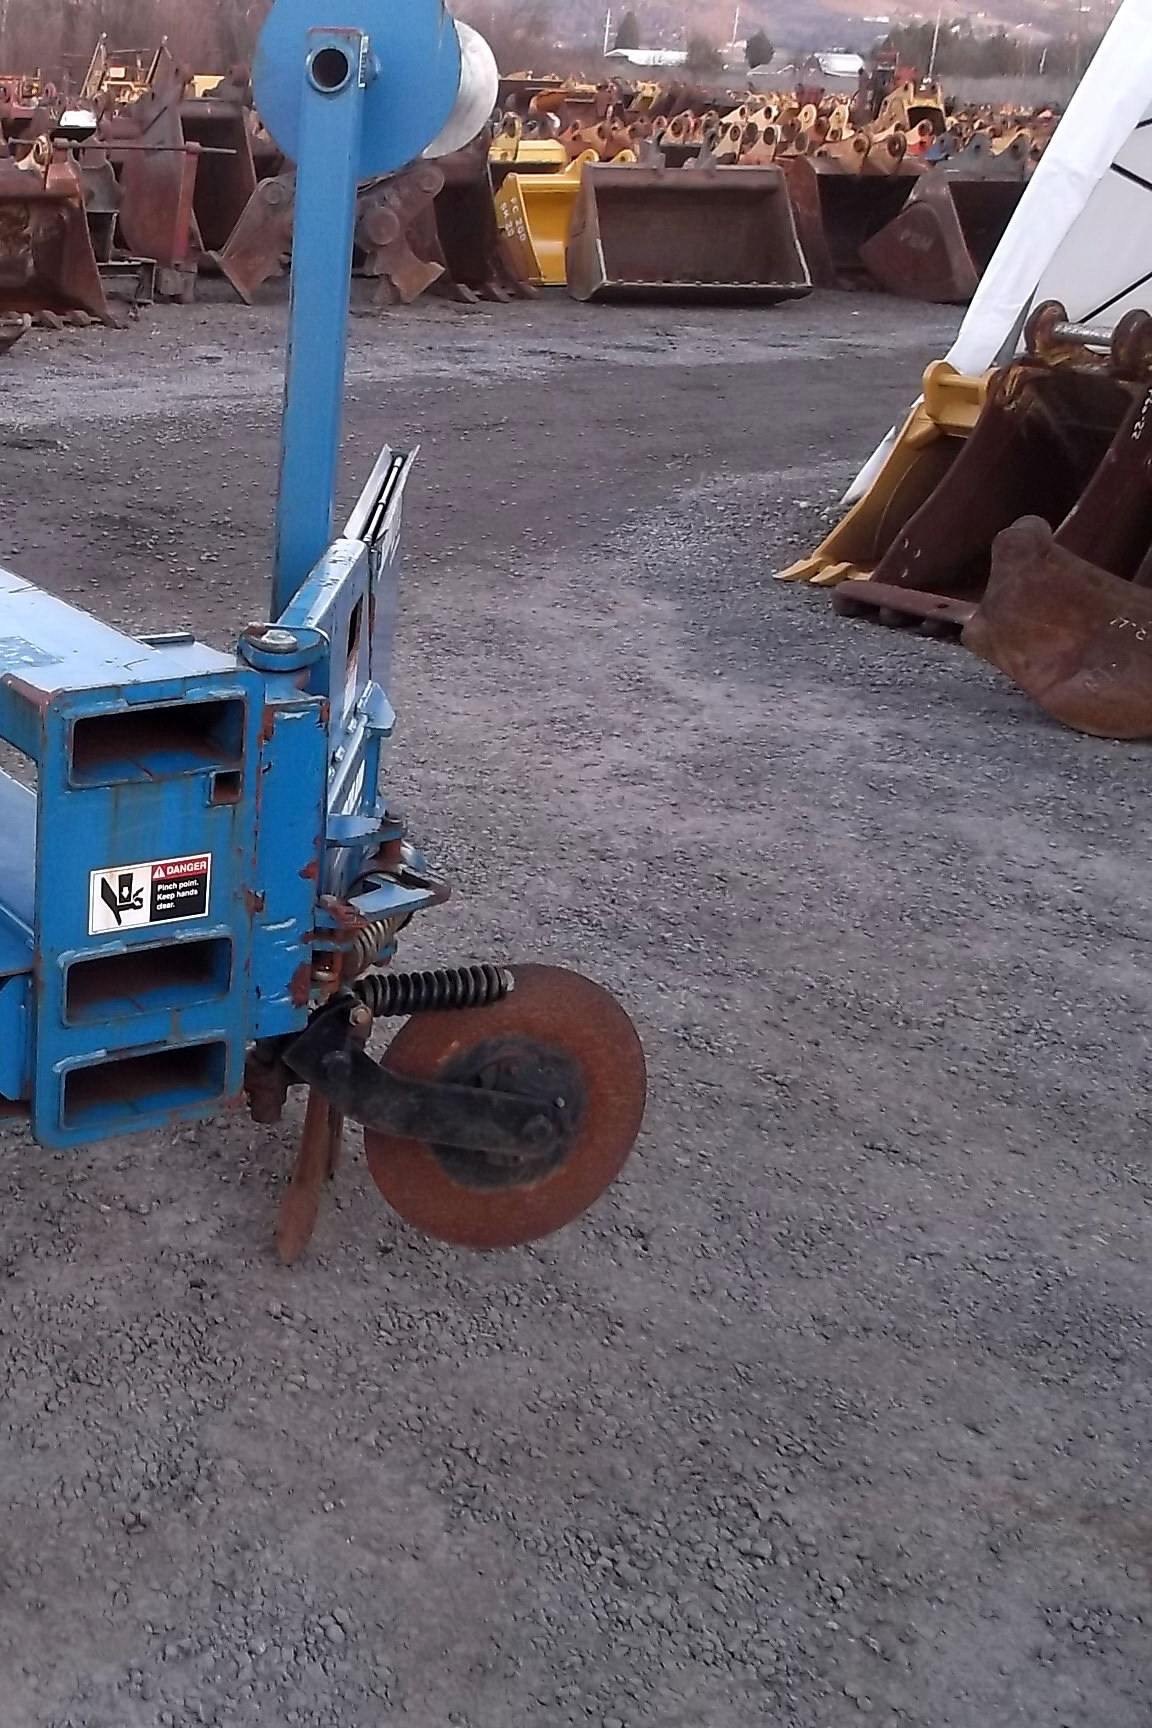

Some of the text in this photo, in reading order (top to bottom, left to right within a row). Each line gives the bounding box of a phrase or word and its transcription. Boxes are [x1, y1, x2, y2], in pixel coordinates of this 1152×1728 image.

[166, 861, 207, 875] DANGER
[157, 880, 199, 891] Pinch point.
[157, 889, 198, 901] Keep hands
[157, 902, 175, 910] clear.
